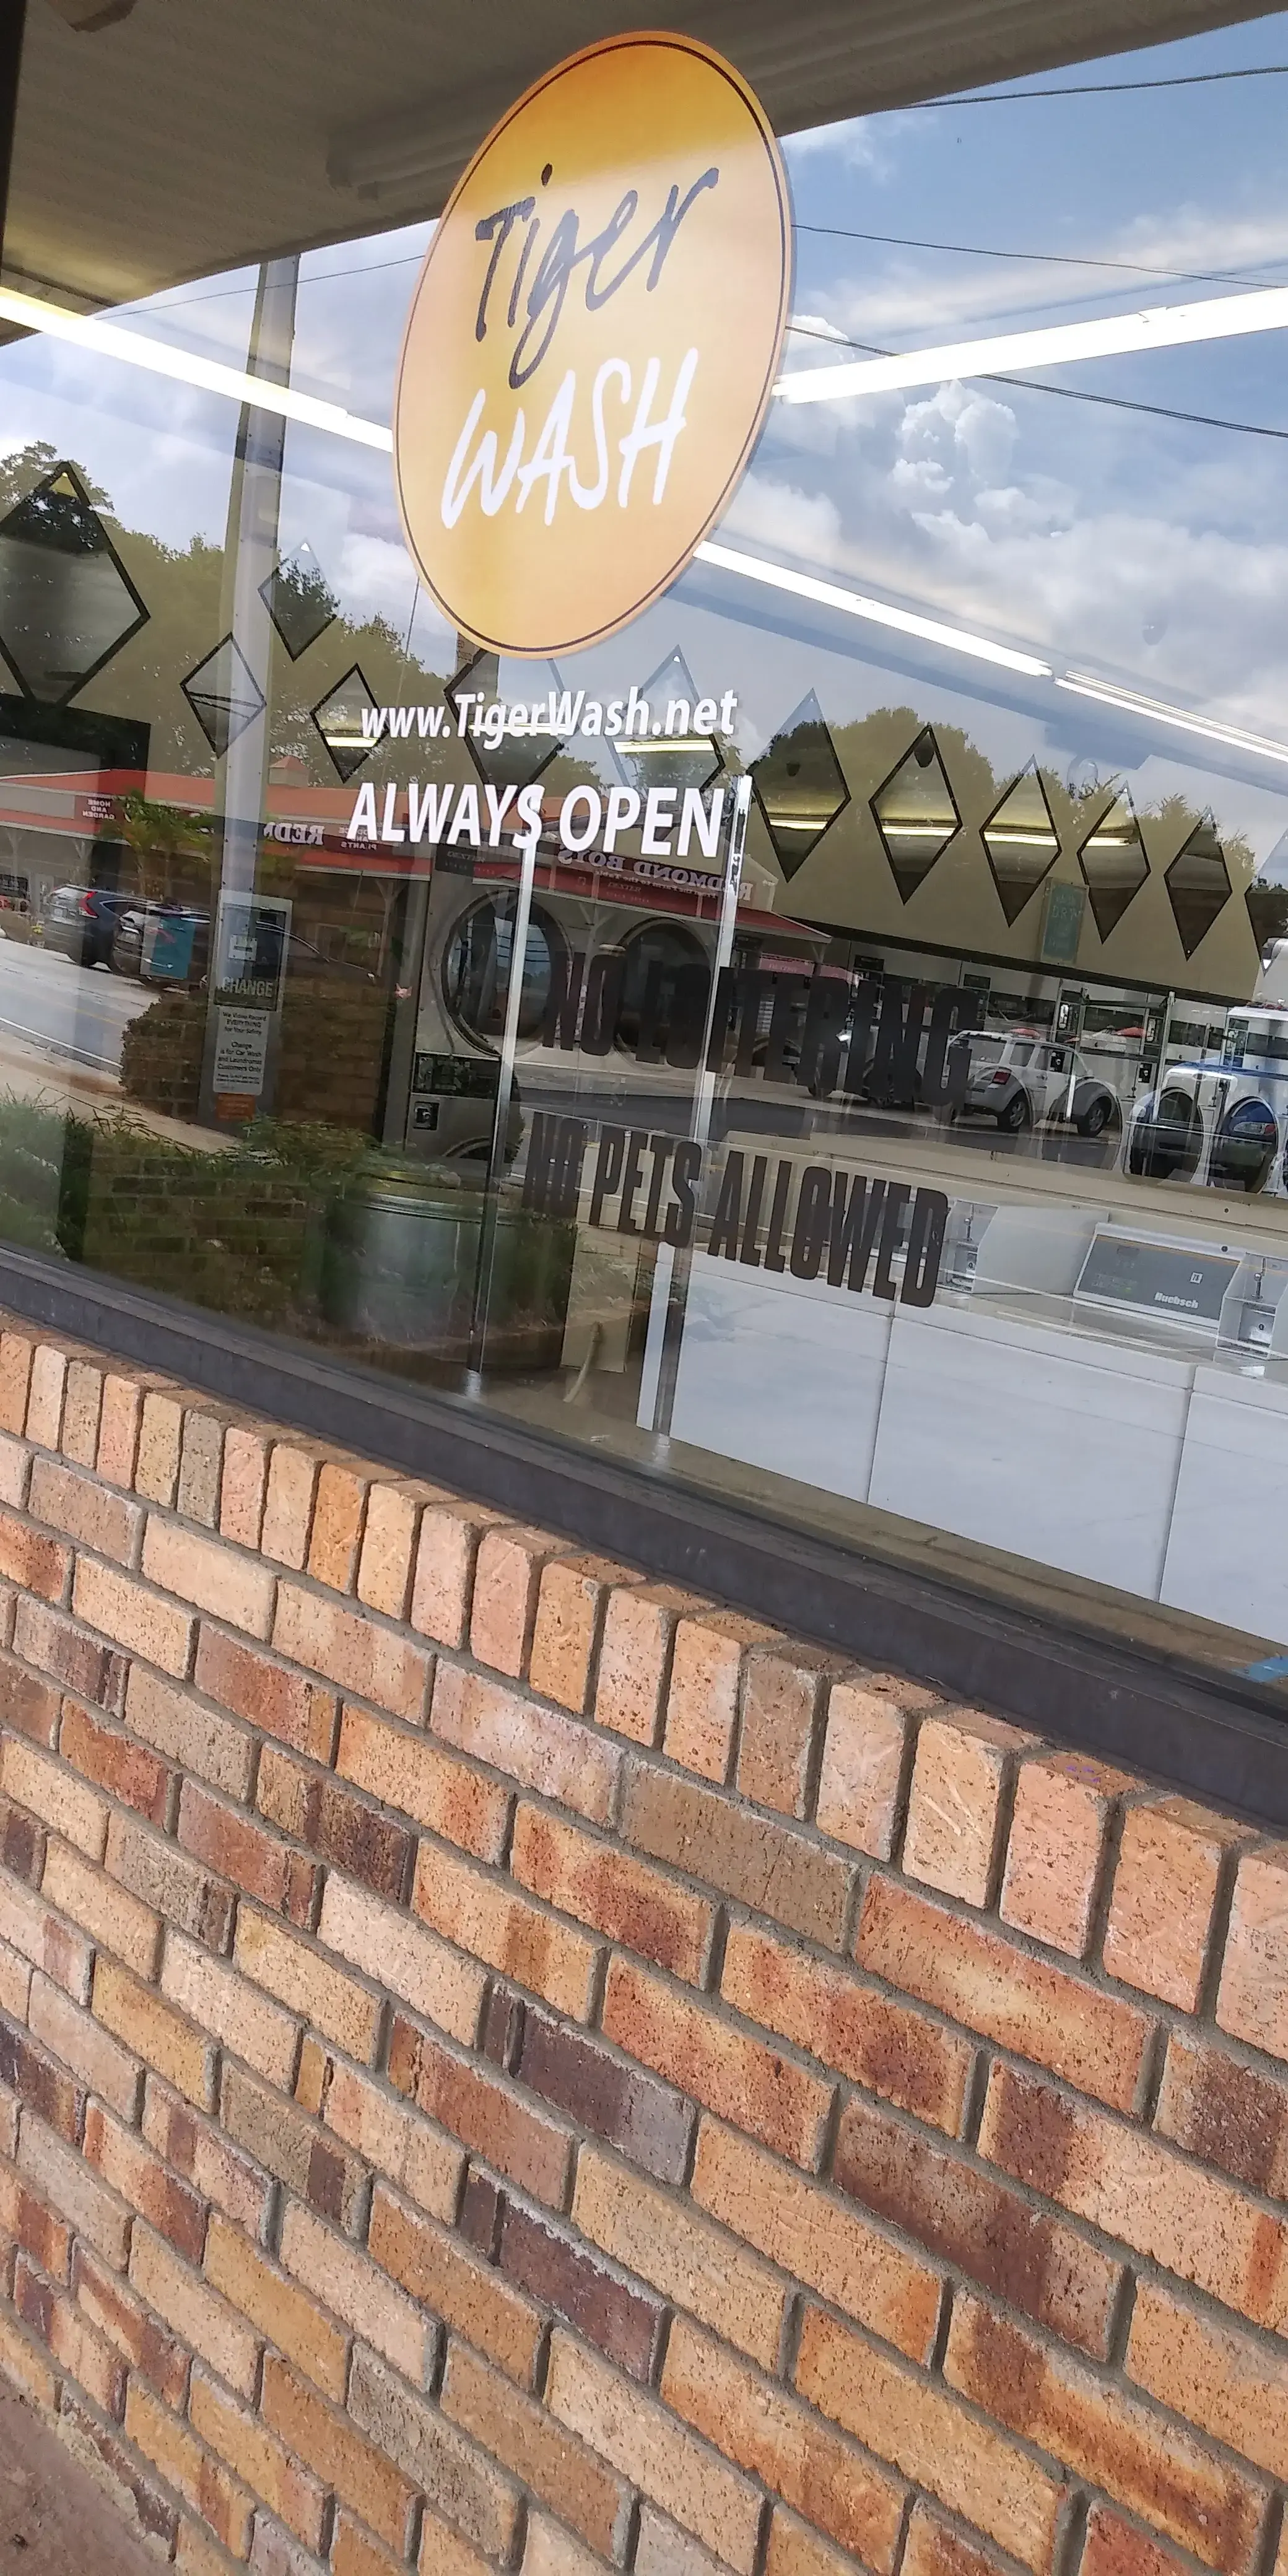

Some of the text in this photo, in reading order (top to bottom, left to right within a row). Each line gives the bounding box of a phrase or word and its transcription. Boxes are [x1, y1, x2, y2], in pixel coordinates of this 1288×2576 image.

[475, 163, 719, 389] Tiger
[440, 347, 698, 529] WASH
[360, 687, 738, 750] www.TigerWash.net
[347, 782, 724, 858] ALWAYS OPEN
[222, 977, 273, 998] CHANGE
[542, 952, 978, 1107] NO LOITERING
[523, 1112, 949, 1308] NO PETS ALLOWED
